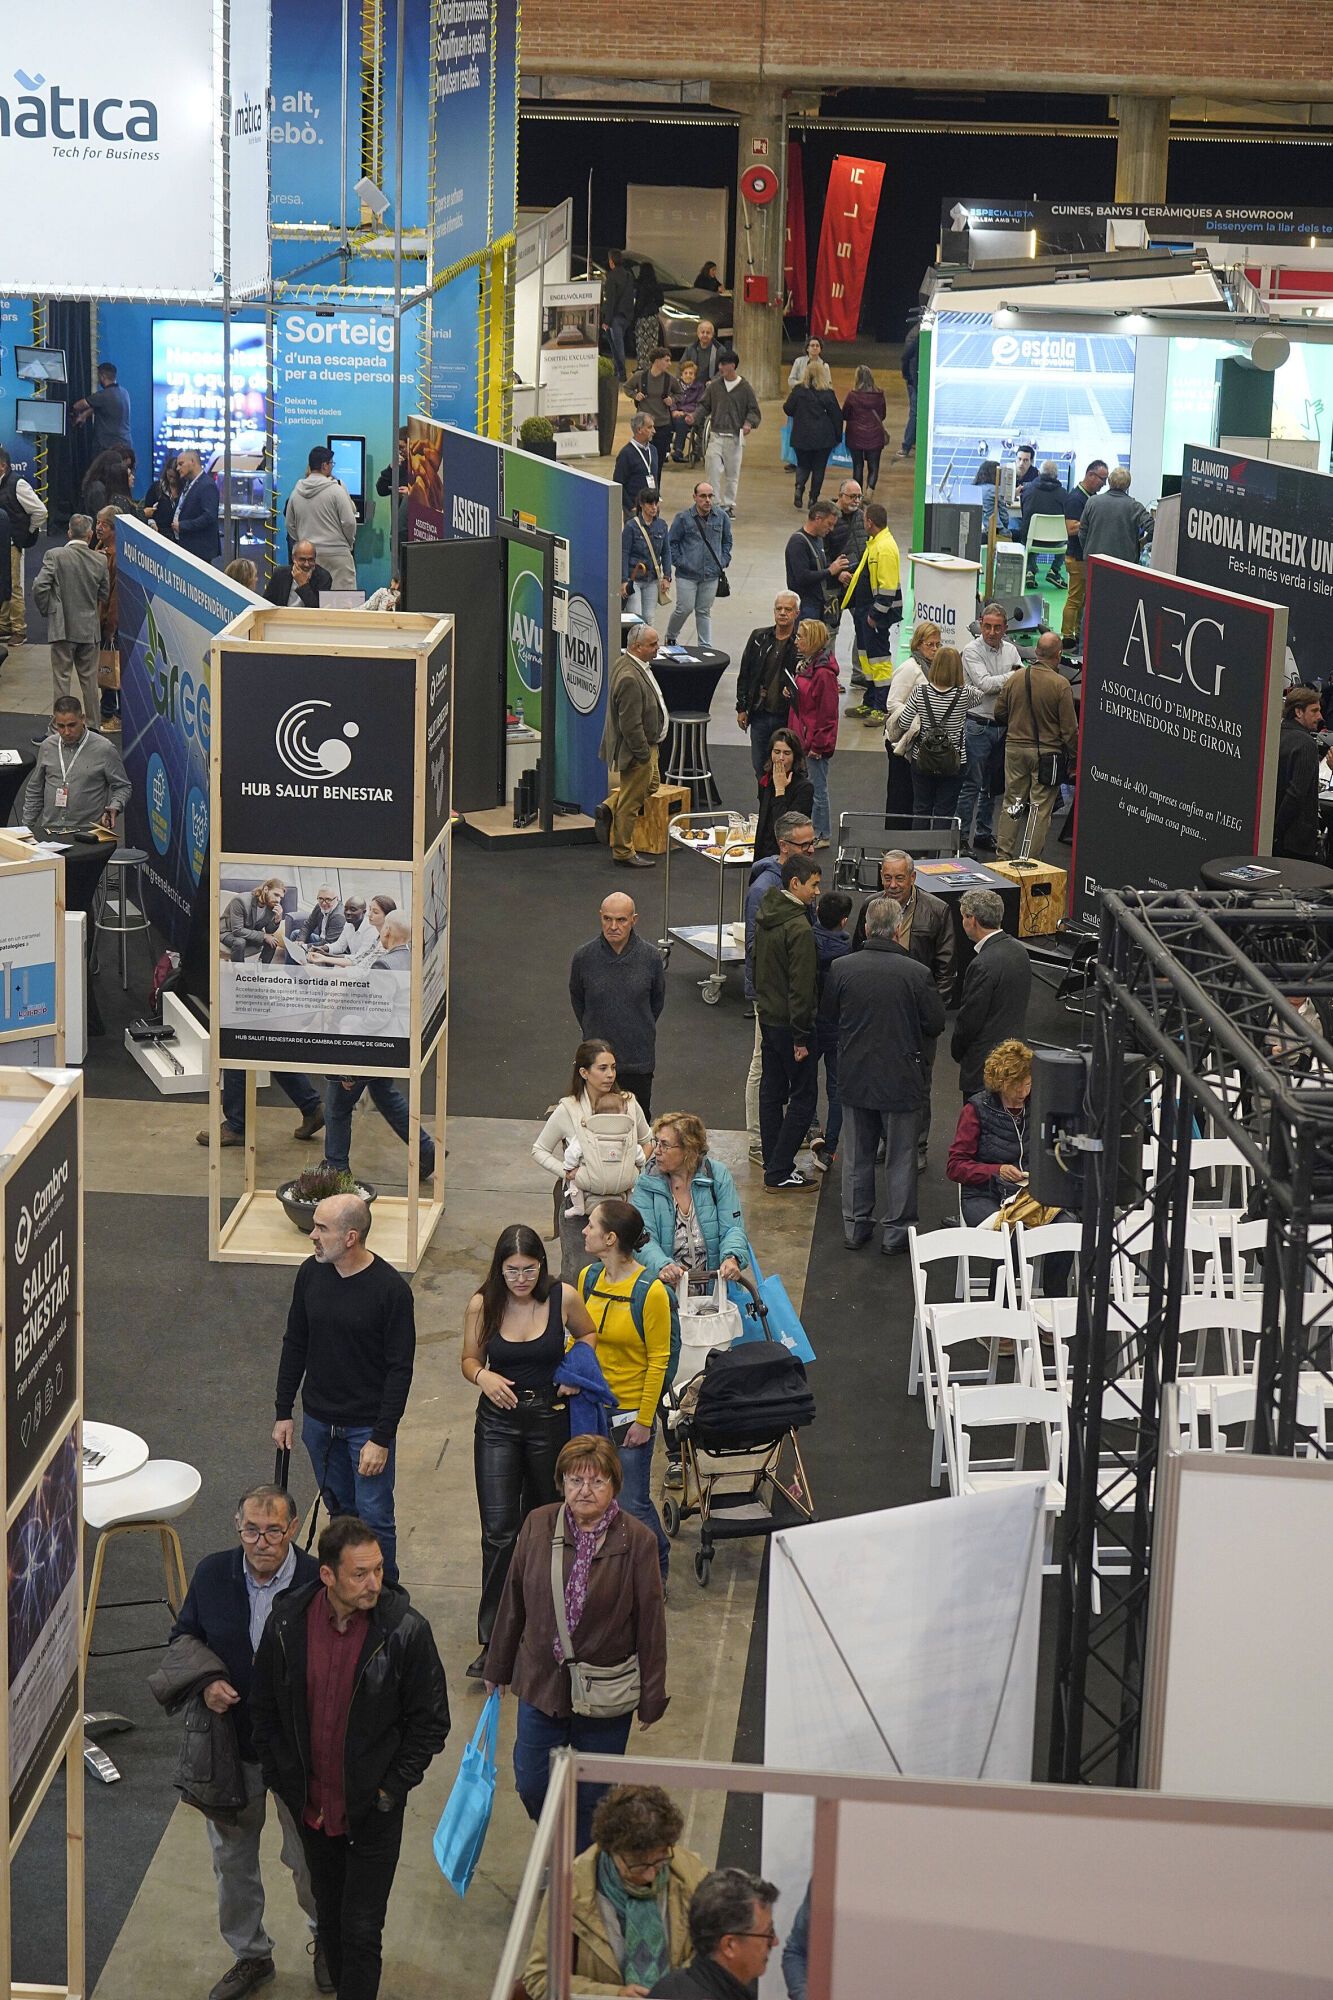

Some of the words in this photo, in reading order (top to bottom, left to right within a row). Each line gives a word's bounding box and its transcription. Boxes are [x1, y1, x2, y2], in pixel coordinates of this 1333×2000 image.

[52, 146, 80, 158] Tech
[83, 147, 102, 160] for
[106, 149, 160, 161] Business
[1051, 206, 1094, 217] CUINES,
[1097, 206, 1132, 217] BANYS
[1135, 207, 1139, 217] I
[1142, 206, 1212, 219] CERÀMIQUES
[1215, 209, 1224, 219] A
[1226, 210, 1293, 220] SHOWROOM
[1207, 221, 1263, 232] Dissenyem
[1267, 223, 1276, 232] la
[1279, 222, 1295, 232] llar
[1299, 222, 1319, 233] dels
[286, 316, 394, 353] Sorteig
[1022, 336, 1076, 359] escala
[285, 352, 321, 365] d'una
[324, 354, 387, 369] escapada
[285, 370, 307, 382] per
[309, 371, 317, 380] a
[320, 369, 351, 381] dues
[297, 407, 317, 415] teves
[1192, 458, 1229, 480] BLANMOTO
[1187, 507, 1244, 552] GIRONA
[1248, 522, 1308, 568] MEREIX
[123, 541, 138, 563] AQUÍ
[138, 551, 164, 583] COMENÇA
[164, 569, 173, 587] LA
[173, 573, 187, 596] TEVA
[1228, 556, 1256, 576] Fes-la
[1259, 565, 1278, 585] més
[1280, 573, 1306, 590] verda
[917, 602, 955, 625] escala
[565, 634, 598, 672] MBM
[567, 672, 598, 695] ALUMINIOS
[1100, 679, 1162, 710] ASSOCIACIÓ
[1164, 700, 1242, 738] D'EMPRESARIS
[1100, 698, 1104, 711] i
[1106, 704, 1180, 738] EMPRENEDORS
[1182, 728, 1197, 747] DE
[1199, 733, 1241, 759] GIRONA
[241, 782, 271, 796] HUB
[276, 784, 319, 799] SALUT
[323, 786, 393, 802] BENESTAR
[1090, 765, 1109, 782] Quan
[1110, 774, 1122, 787] més
[1123, 777, 1131, 792] de
[1133, 781, 1148, 796] 400
[1149, 790, 1178, 808] empreses
[1179, 801, 1204, 818] confien
[1205, 811, 1214, 822] en
[1118, 797, 1125, 809] és
[1126, 804, 1139, 816] que
[1140, 806, 1164, 824] alguna
[1165, 816, 1180, 829] cosa
[1181, 823, 1207, 841] passa...
[235, 974, 292, 985] Acceleradora
[298, 977, 329, 987] sortida
[330, 979, 338, 987] al
[339, 981, 370, 989] mercat
[33, 1159, 68, 1221] Cambra
[22, 1237, 58, 1315] SALUT
[15, 1265, 69, 1373] BENESTAR
[18, 1377, 28, 1400] Fem
